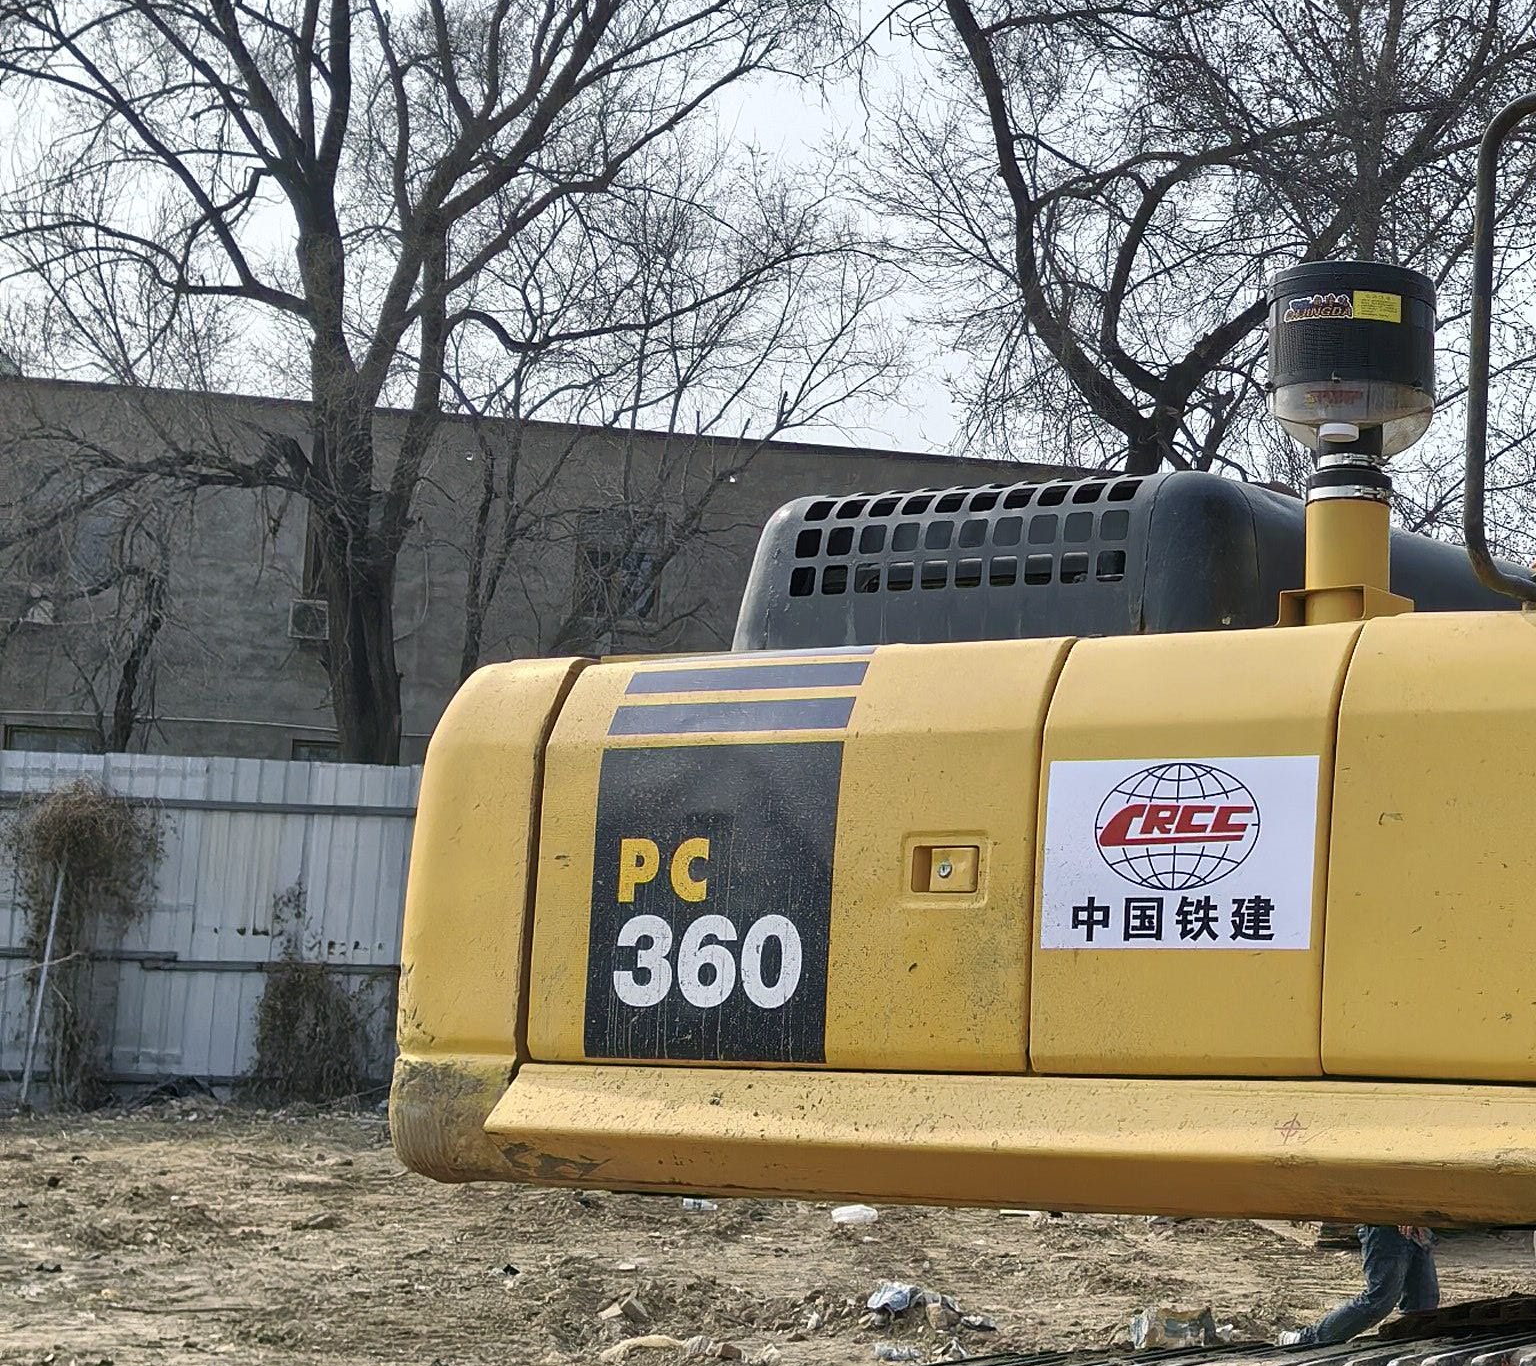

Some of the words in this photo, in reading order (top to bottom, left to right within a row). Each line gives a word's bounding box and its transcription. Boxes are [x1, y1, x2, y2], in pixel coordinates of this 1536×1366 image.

[1099, 803, 1254, 847] CRCC
[617, 837, 710, 904] PC
[1071, 895, 1275, 942] 中国铁建
[613, 914, 802, 1009] 360
